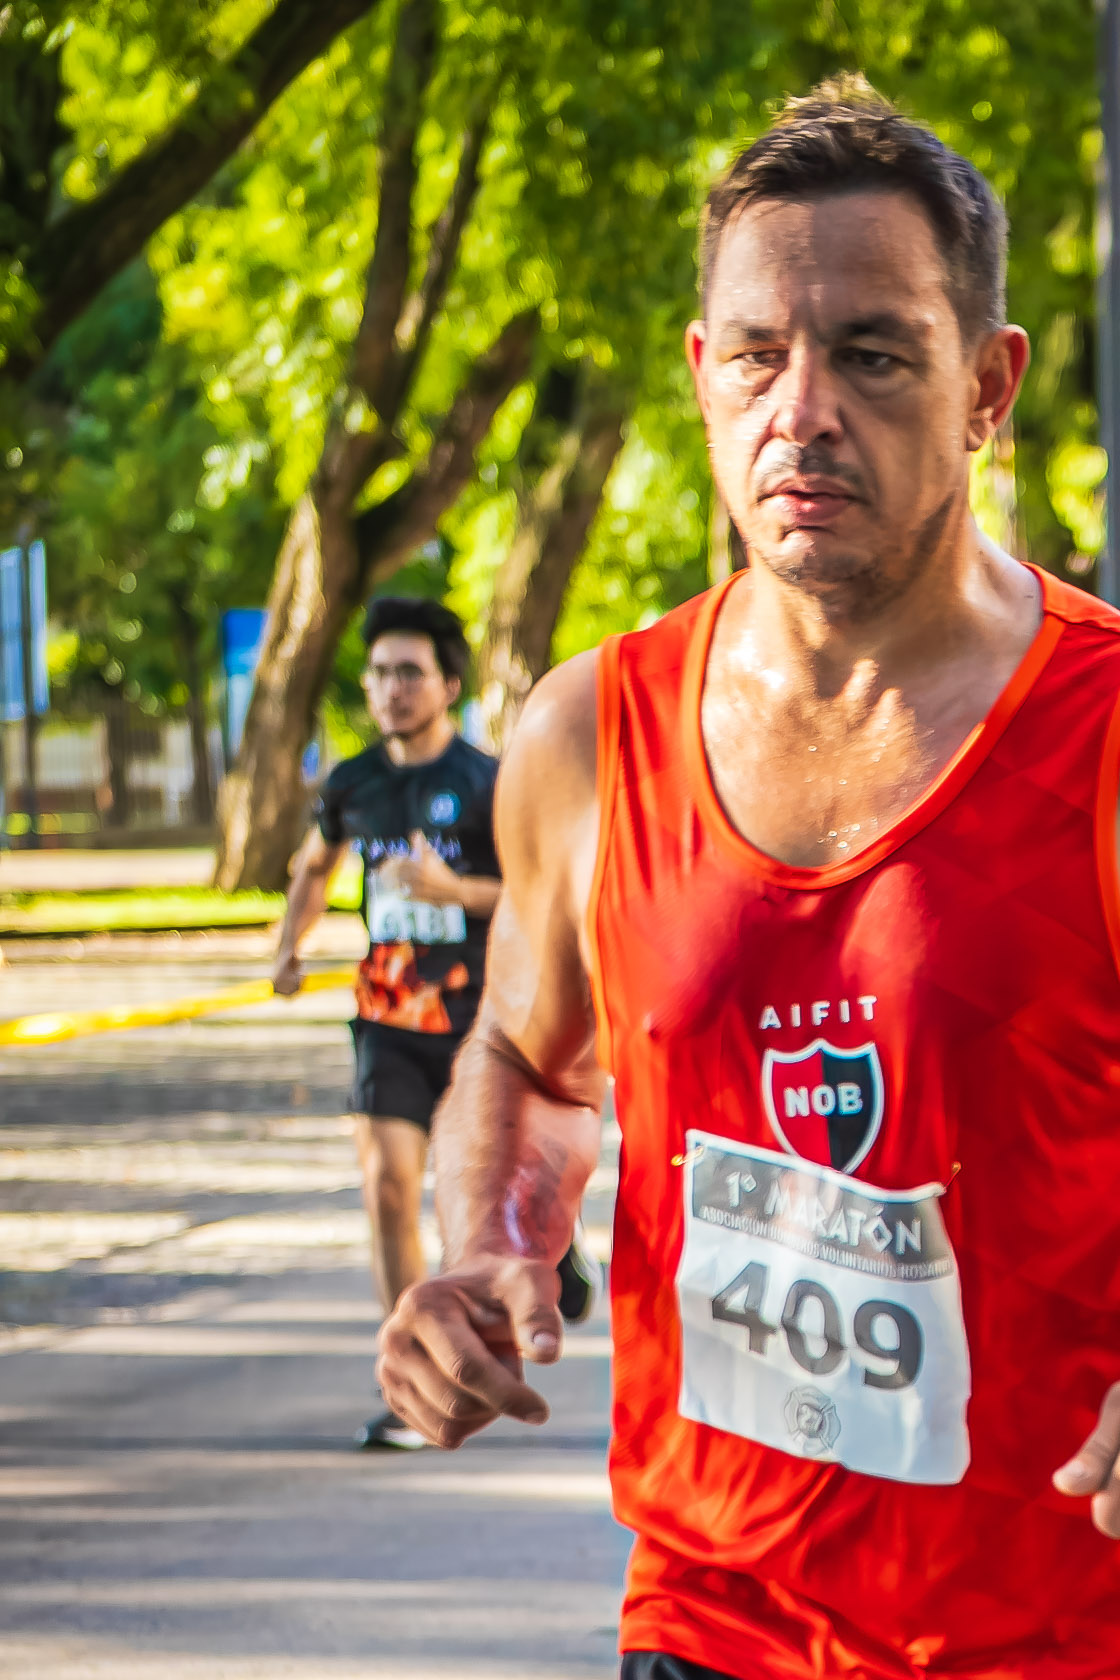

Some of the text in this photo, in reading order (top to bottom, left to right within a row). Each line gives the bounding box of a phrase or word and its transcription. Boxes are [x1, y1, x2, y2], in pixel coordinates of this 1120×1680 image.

[758, 995, 877, 1030] AIFIT
[783, 1082, 864, 1118] NOB
[763, 1178, 922, 1256] MARATÓN
[711, 1261, 925, 1391] 409
